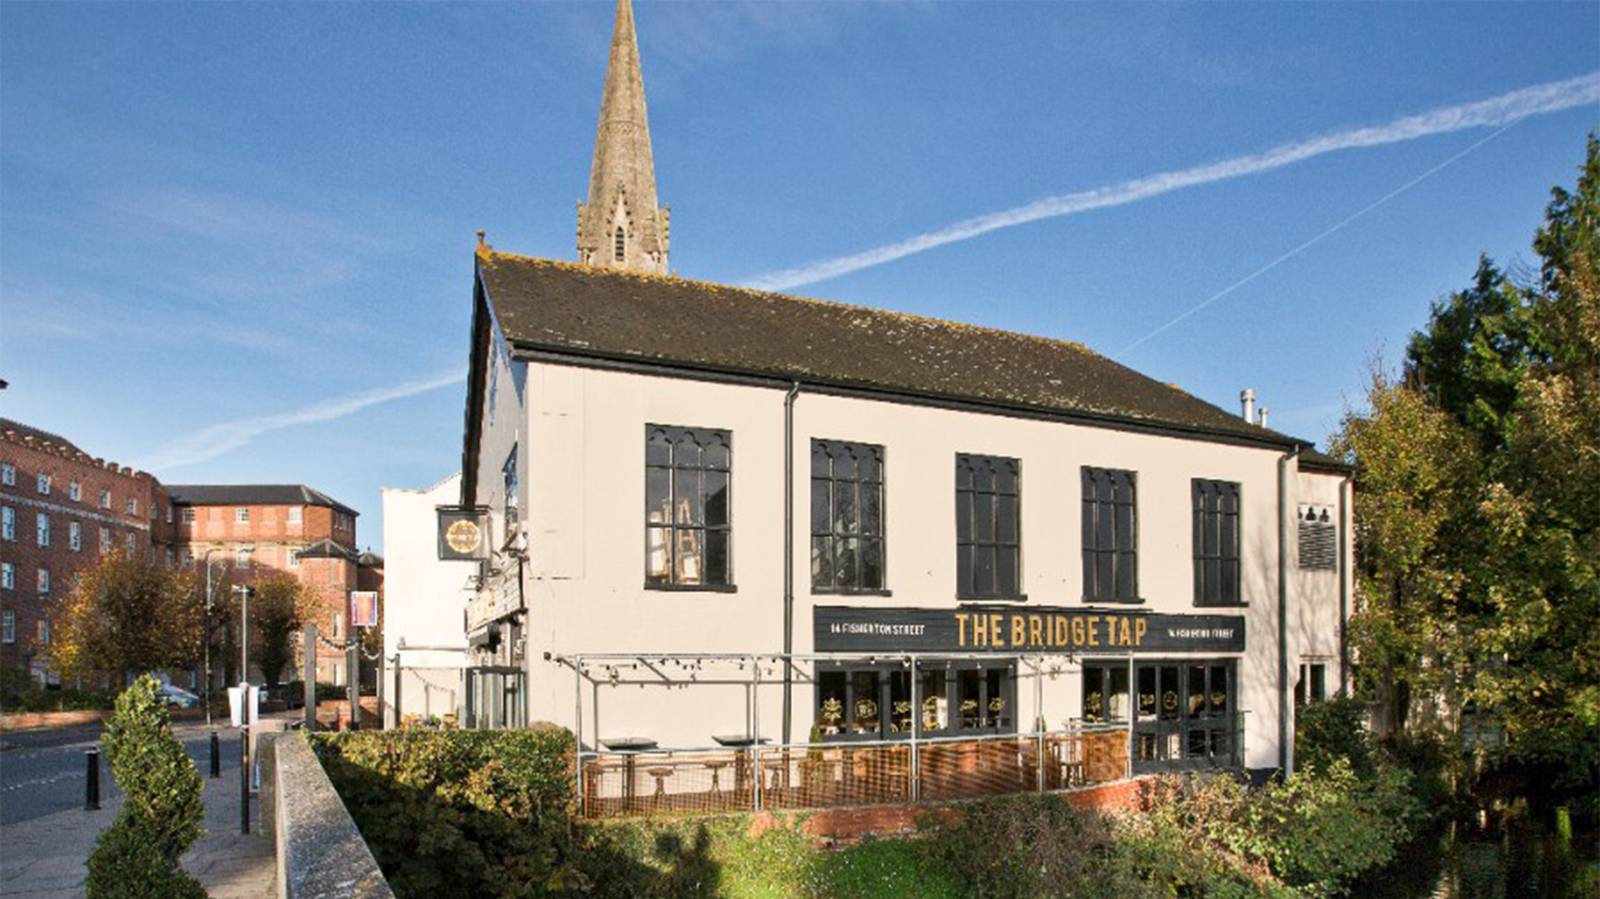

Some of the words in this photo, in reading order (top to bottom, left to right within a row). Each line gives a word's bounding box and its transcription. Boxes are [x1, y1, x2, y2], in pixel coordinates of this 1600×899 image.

[893, 624, 926, 636] STREET
[955, 614, 1004, 646] THE
[1011, 615, 1100, 646] BRIDGE
[1106, 616, 1147, 646] TAP
